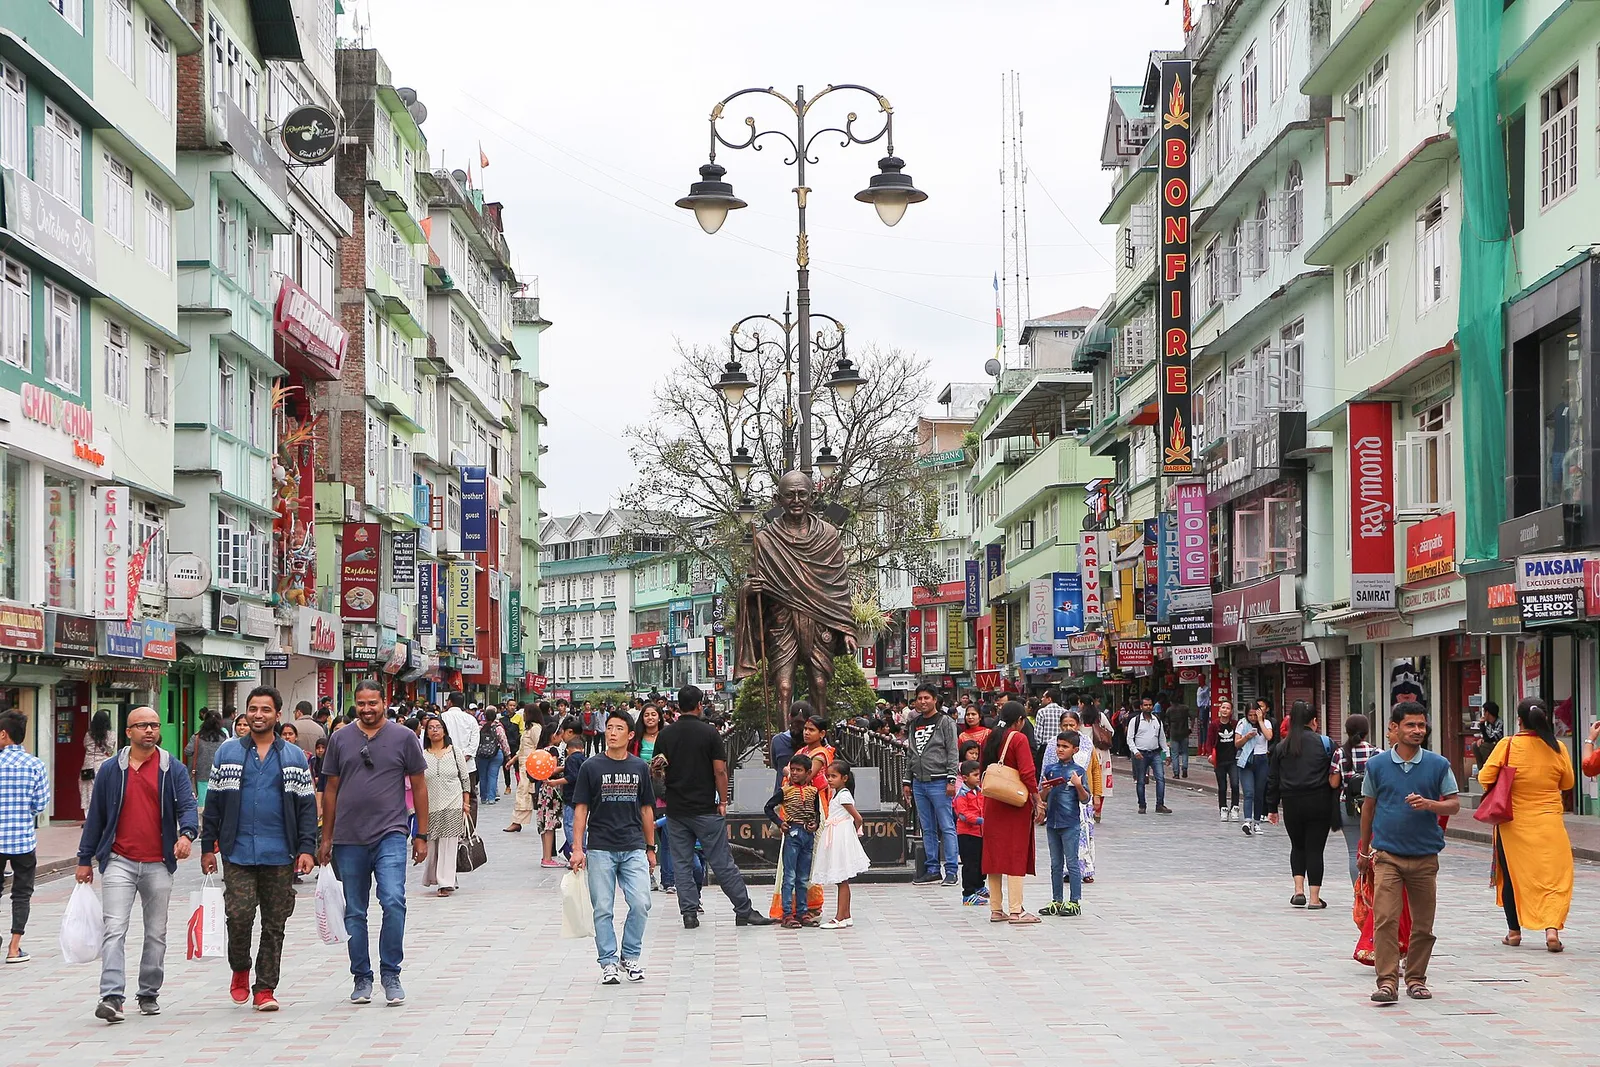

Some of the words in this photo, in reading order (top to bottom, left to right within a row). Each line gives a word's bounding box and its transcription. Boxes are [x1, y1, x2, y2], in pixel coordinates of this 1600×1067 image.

[36, 190, 70, 249] October
[72, 218, 94, 265] Sky
[1165, 139, 1188, 394] BONFIRE
[1054, 330, 1069, 338] THE
[21, 382, 52, 426] CHAI
[62, 400, 94, 443] CHUN
[462, 492, 485, 500] brothers'
[1181, 487, 1203, 499] ALFA
[105, 490, 117, 542] CHAI
[465, 512, 480, 520] guest
[465, 532, 481, 540] house
[1184, 502, 1206, 580] LODGE
[1084, 535, 1100, 614] PARIVAR
[1525, 558, 1587, 577] PAKSAM
[105, 557, 116, 610] CHUN
[421, 566, 429, 591] LAXMI
[457, 569, 469, 608] house
[1526, 578, 1560, 587] EXCLUSIVE
[1356, 590, 1390, 602] SAMRAT
[1539, 594, 1553, 602] PASS
[421, 595, 429, 624] SWEETS
[1034, 581, 1050, 643] firstcry
[1522, 602, 1574, 612] XEROX
[457, 614, 469, 637] roll
[1187, 622, 1213, 630] RESTAURANT
[996, 627, 1004, 664] GOLDEN
[1073, 635, 1098, 644] PARIVAR
[602, 774, 611, 784] MY
[614, 774, 630, 783] ROAD
[633, 774, 639, 784] TO
